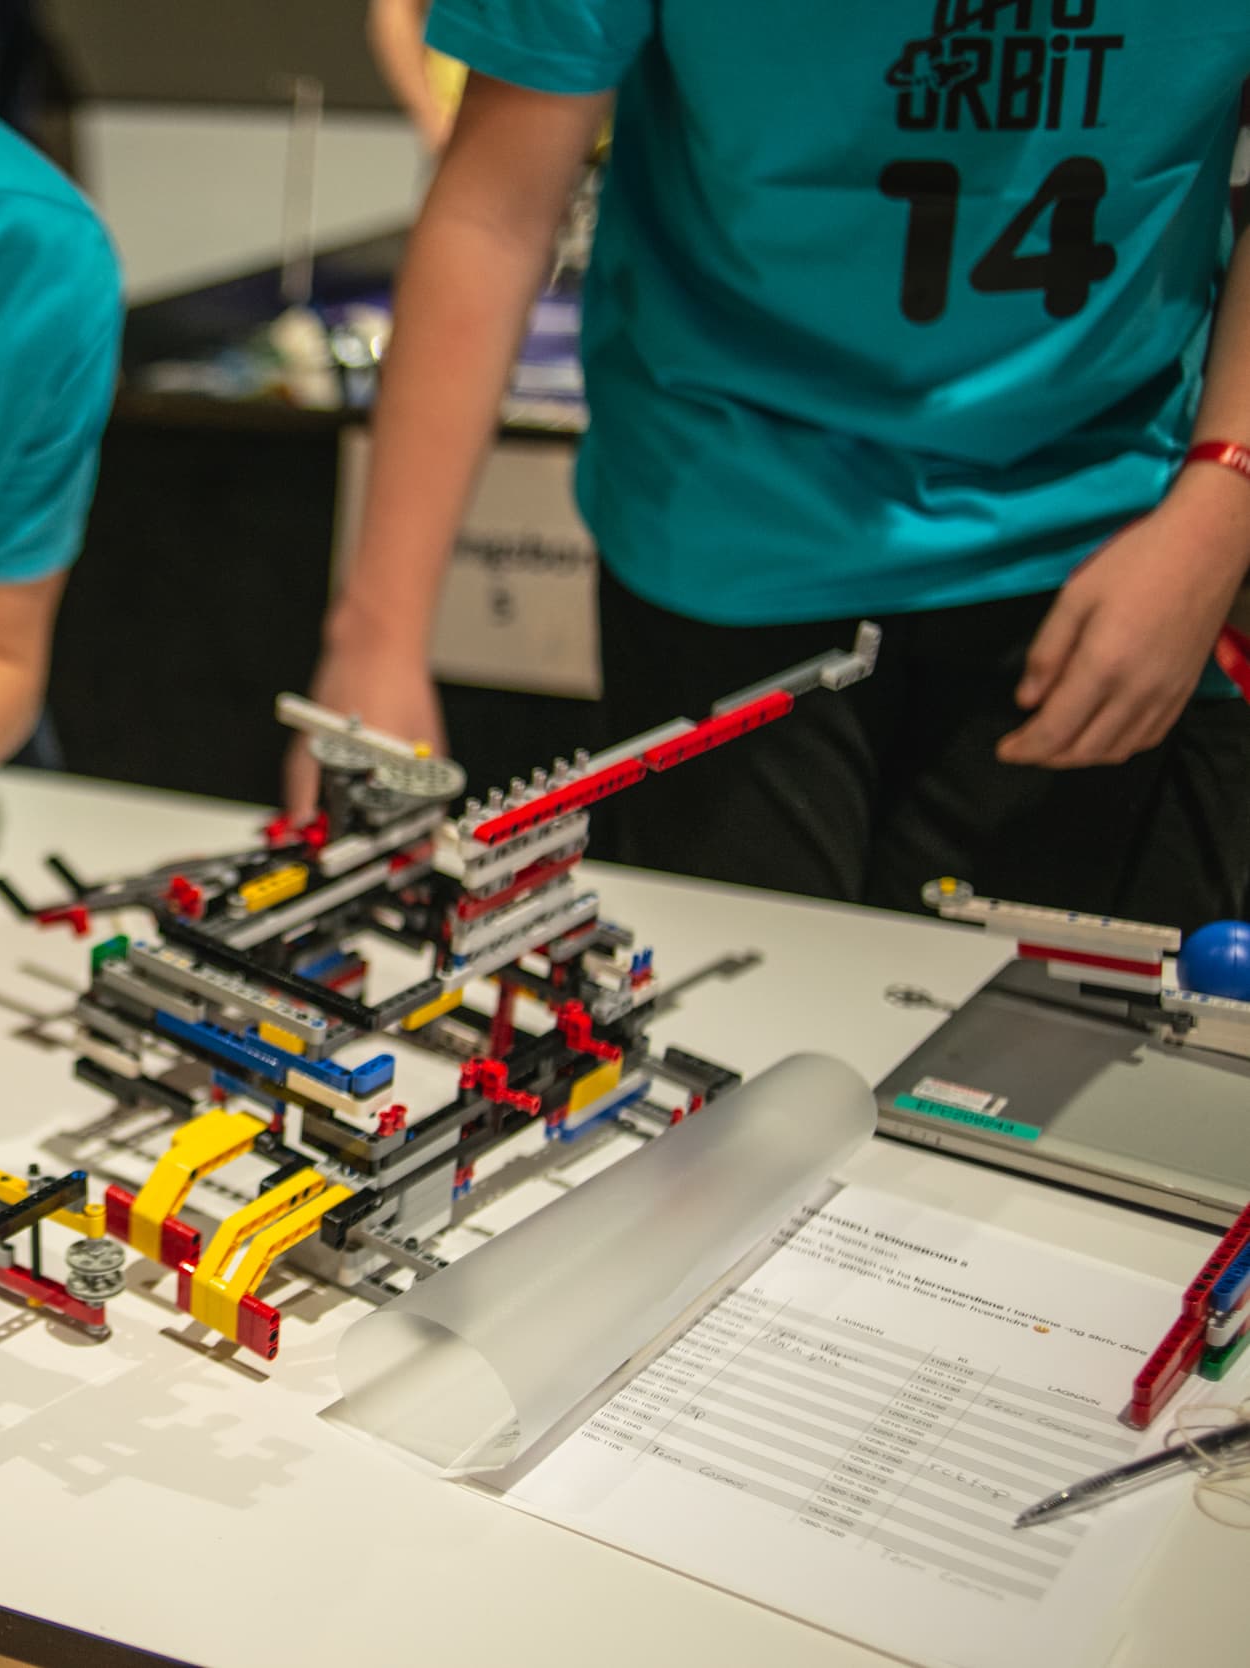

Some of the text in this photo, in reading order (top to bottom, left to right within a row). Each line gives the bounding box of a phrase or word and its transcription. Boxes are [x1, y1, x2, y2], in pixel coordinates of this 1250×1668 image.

[878, 155, 1117, 326] 14
[1087, 1333, 1118, 1347] skriv
[651, 1445, 682, 1464] Team
